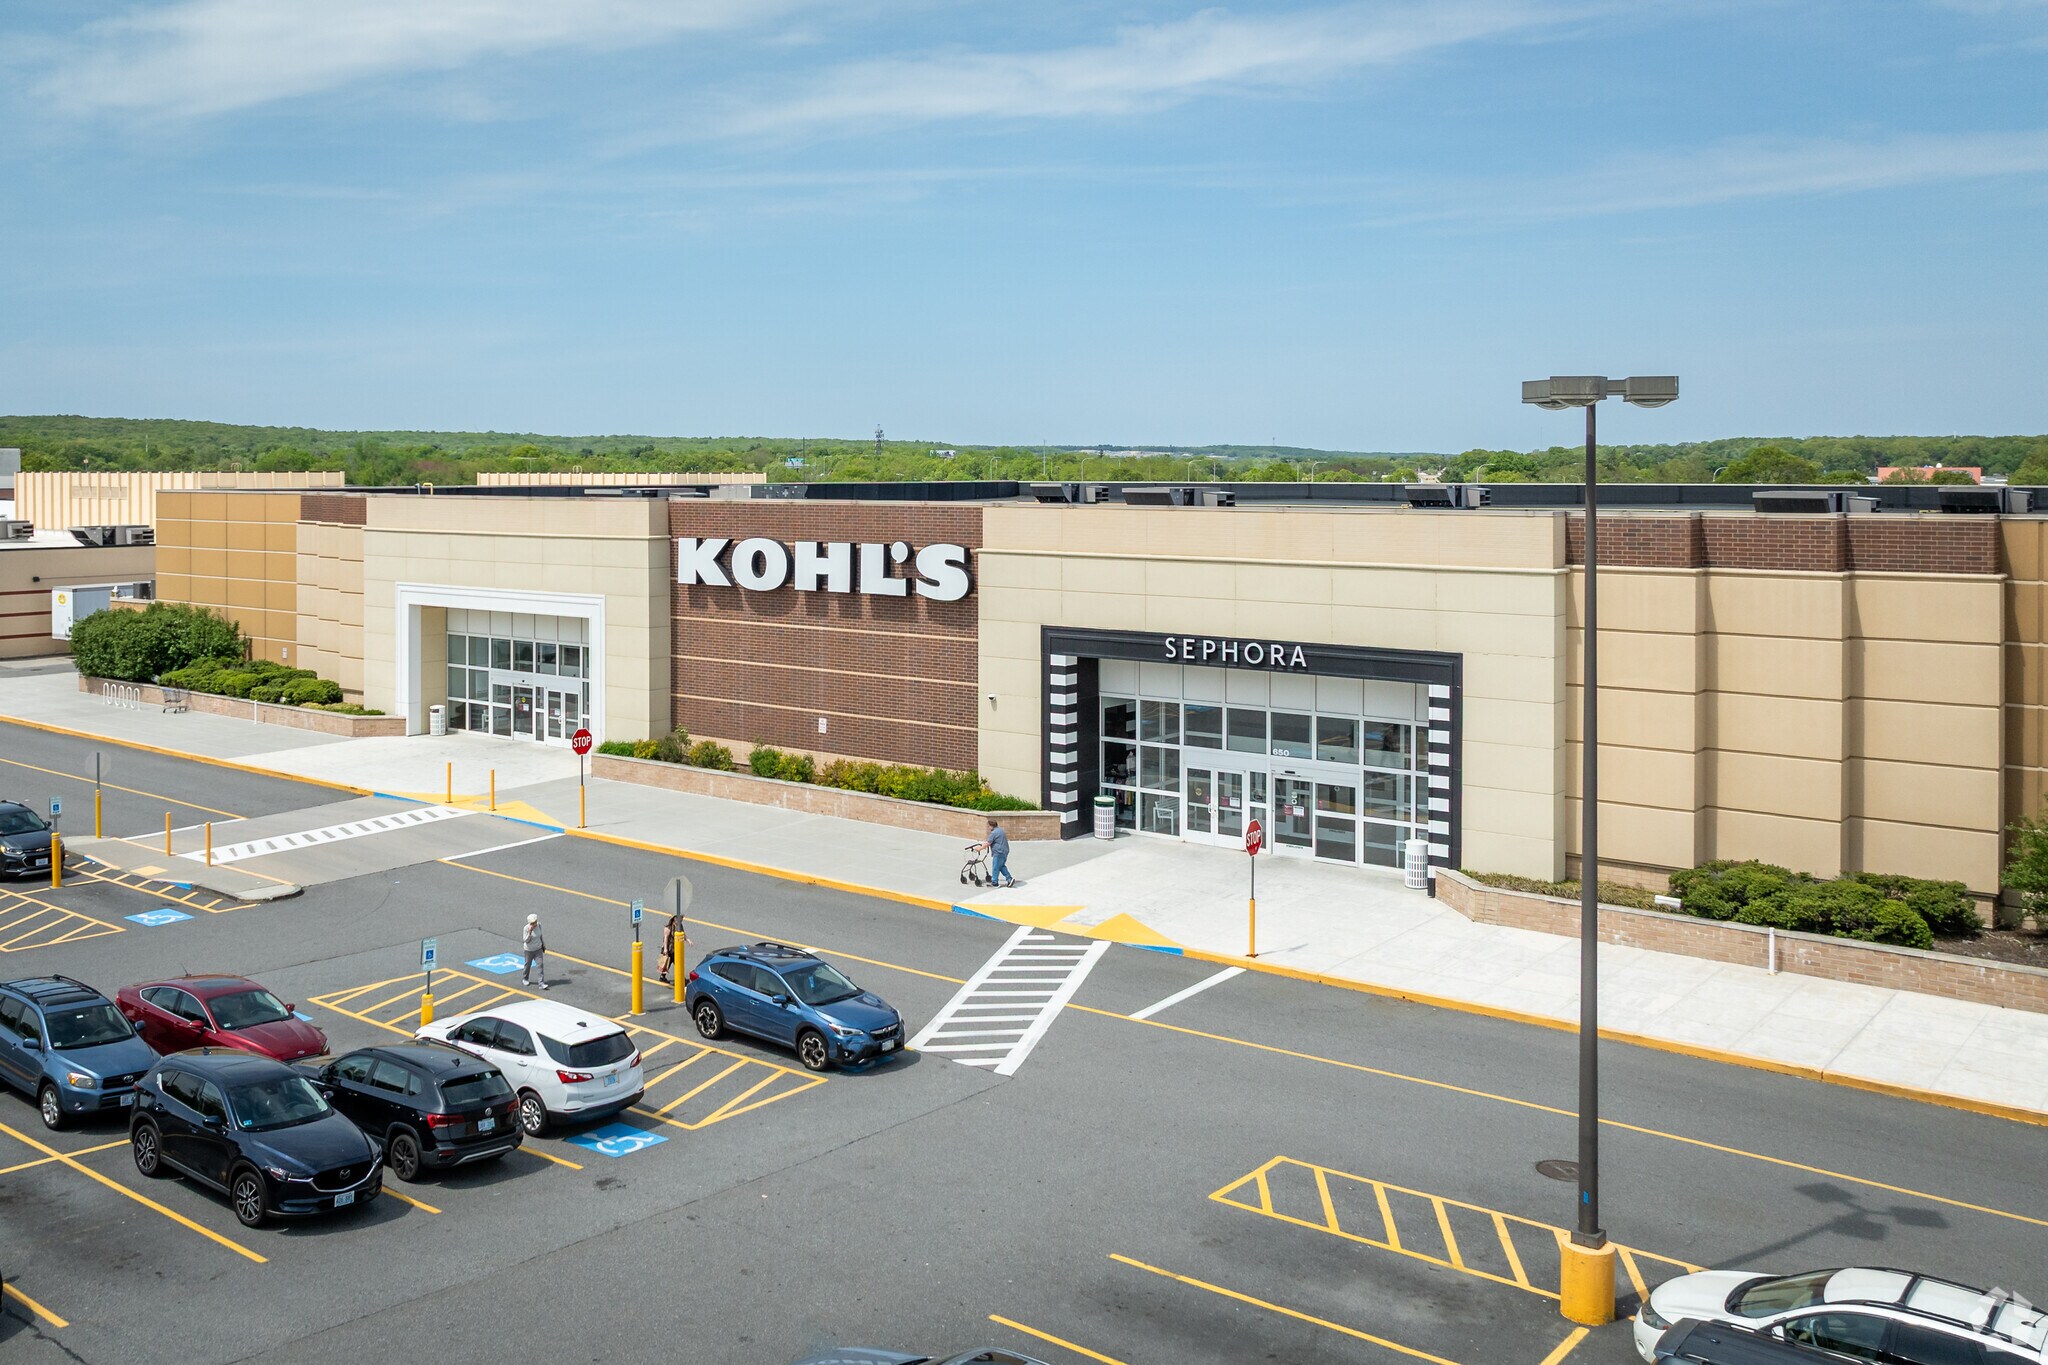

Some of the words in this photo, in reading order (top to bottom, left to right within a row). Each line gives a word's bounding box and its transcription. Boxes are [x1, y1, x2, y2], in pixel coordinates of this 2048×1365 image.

[677, 537, 970, 602] KOHL'S
[1165, 637, 1308, 668] SEPHORA
[573, 735, 592, 748] STOP
[1272, 748, 1290, 757] 650
[1246, 829, 1262, 847] STOP
